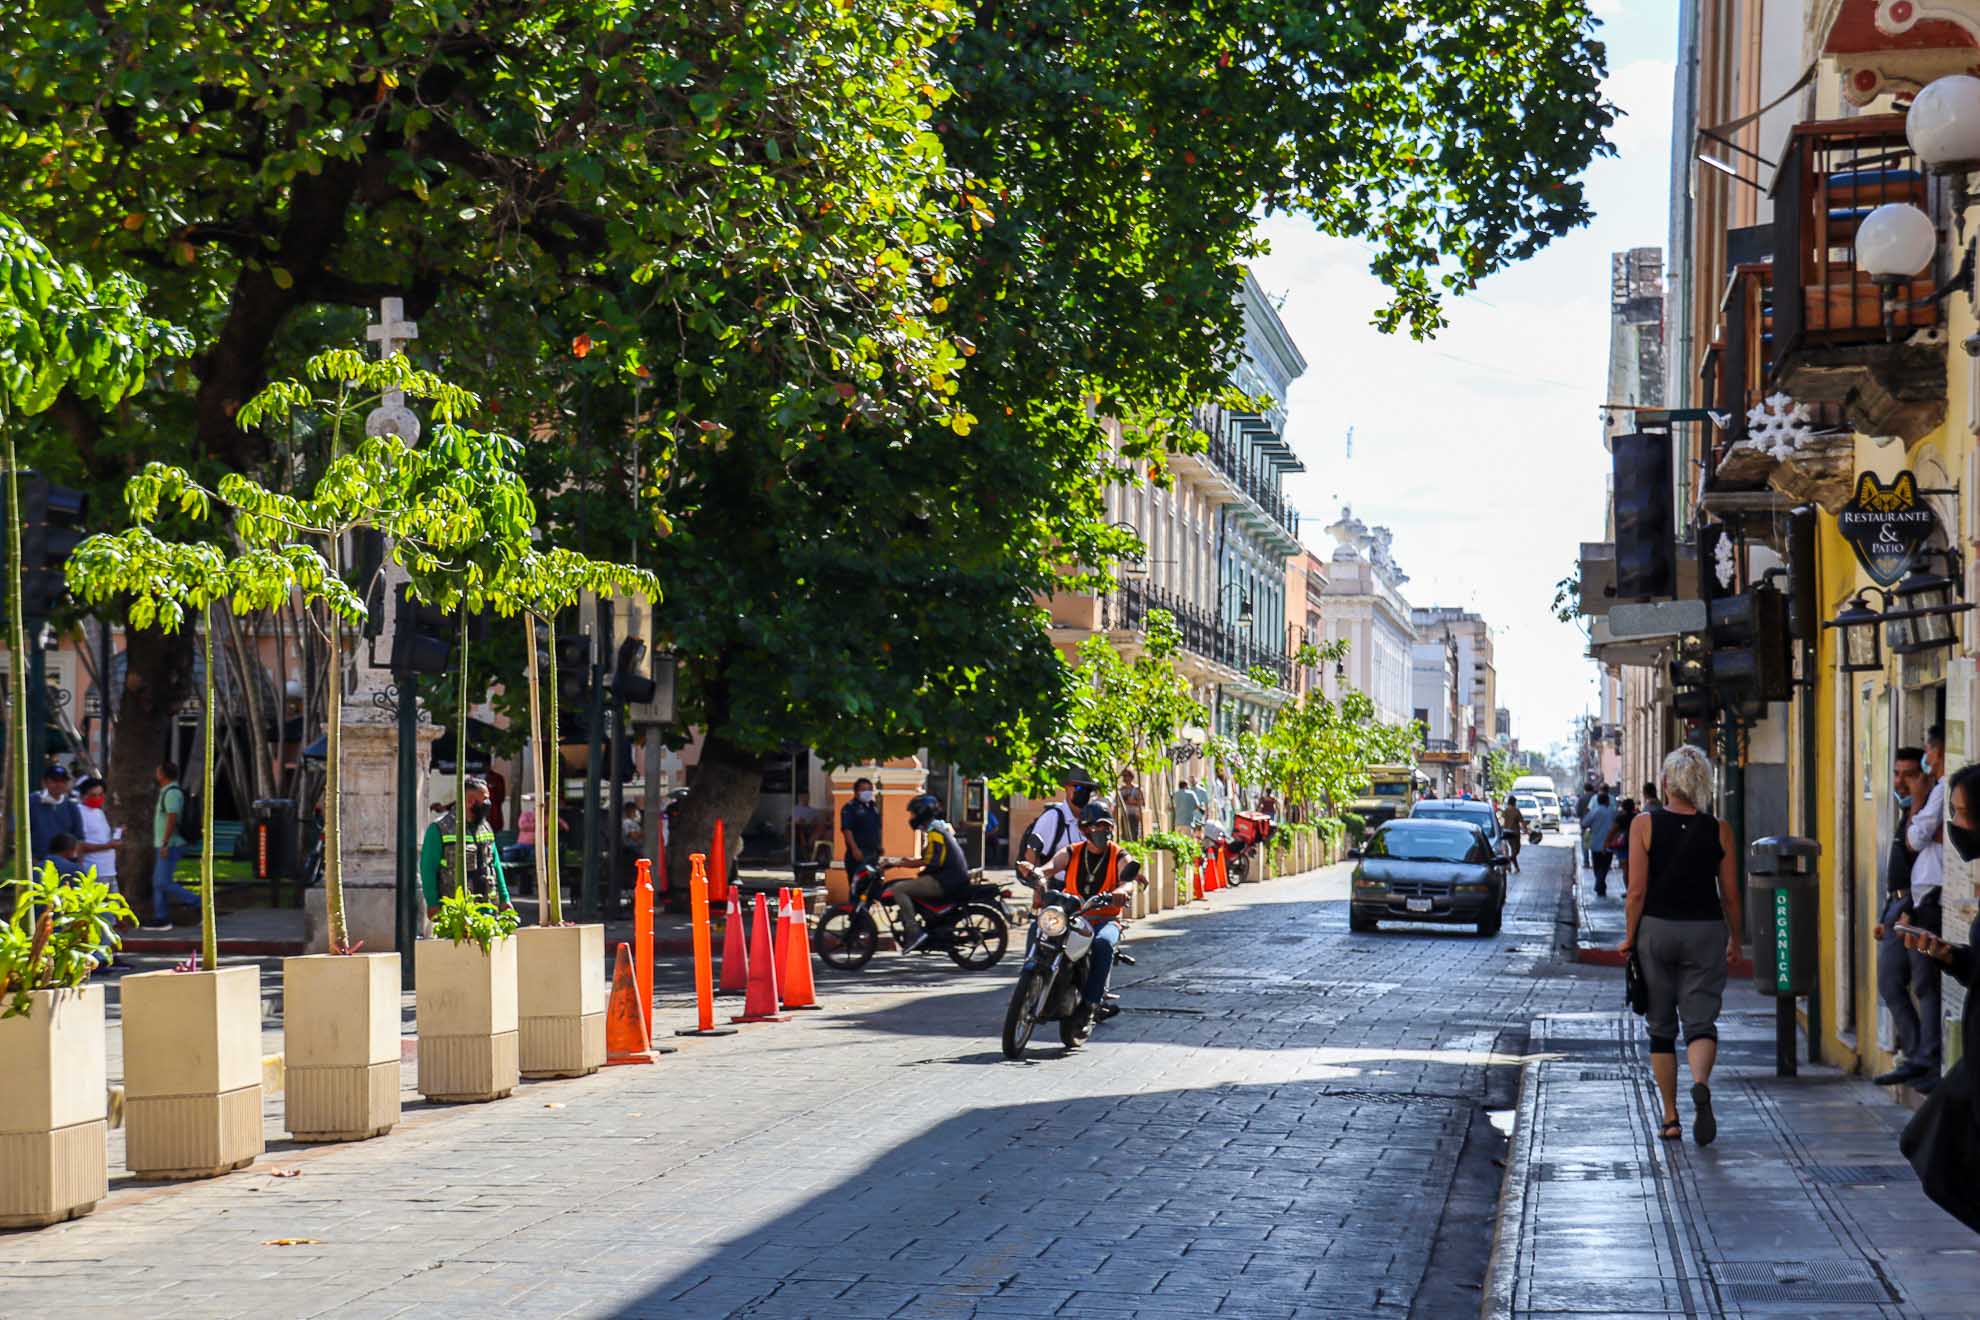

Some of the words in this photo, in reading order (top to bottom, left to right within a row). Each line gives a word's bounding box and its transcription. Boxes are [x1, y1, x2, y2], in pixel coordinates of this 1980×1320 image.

[1844, 512, 1929, 523] RESTAURANTE
[1879, 523, 1898, 542] &
[1872, 543, 1904, 553] PATIO
[1777, 895, 1788, 982] ORGANICA
